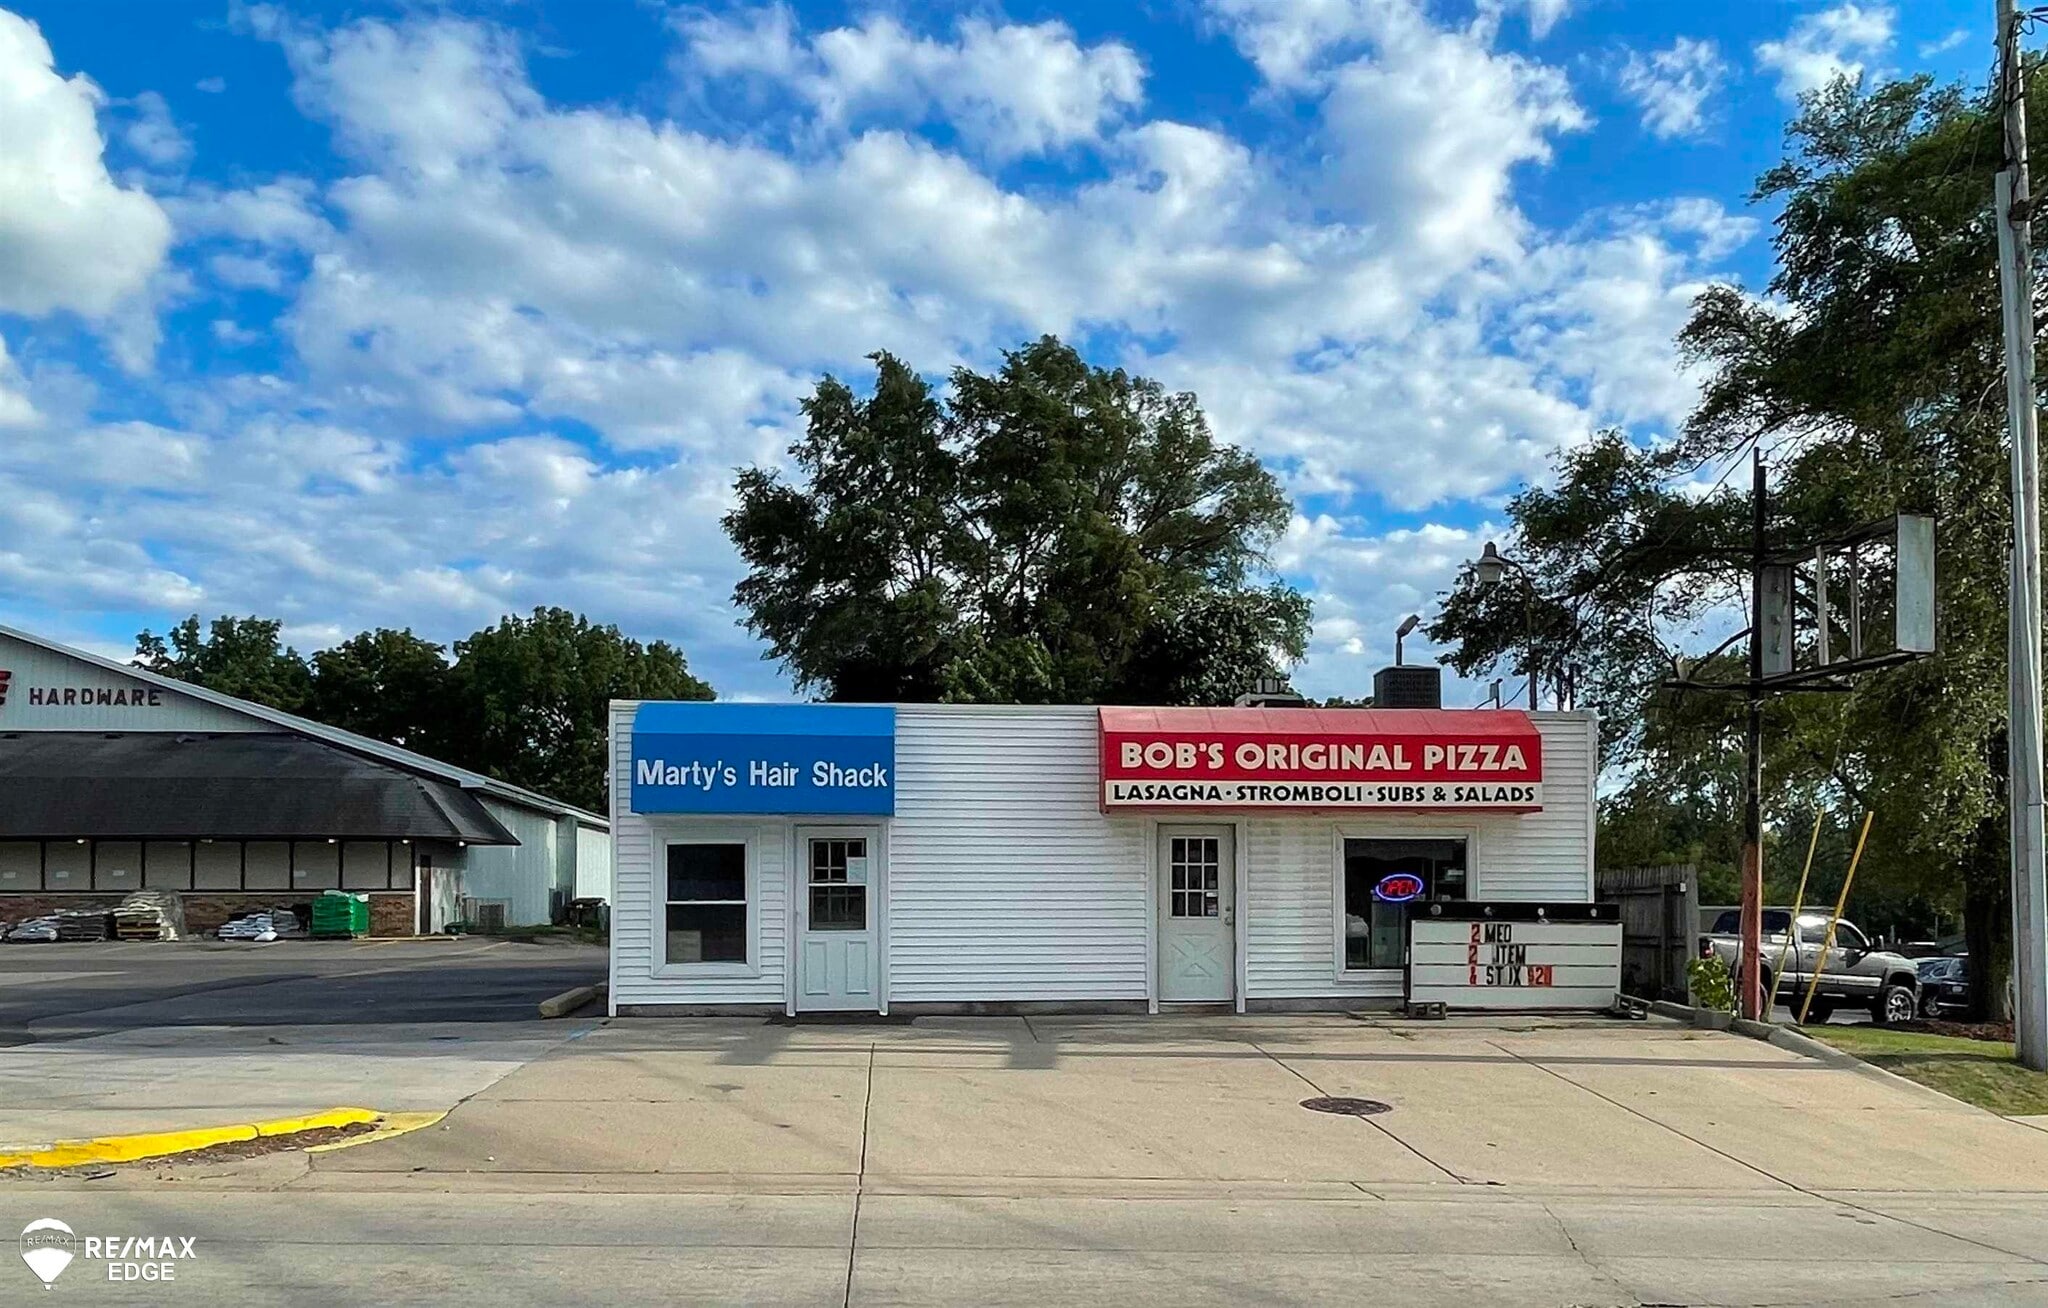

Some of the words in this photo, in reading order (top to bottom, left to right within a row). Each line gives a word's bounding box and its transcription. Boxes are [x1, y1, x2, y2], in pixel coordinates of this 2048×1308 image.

[29, 687, 162, 706] HARDWARE
[1121, 742, 1225, 770] BOB'S
[1235, 743, 1412, 770] ORIGINAL
[1424, 744, 1528, 771] PIZZA
[636, 759, 737, 791] Marty's
[750, 760, 799, 787] Hair
[812, 760, 888, 787] Shack
[1114, 784, 1223, 801] LASAGNA
[1237, 785, 1362, 801] STROMBOLI
[1377, 786, 1425, 802] SUBS
[1432, 786, 1447, 802] &
[1454, 786, 1535, 802] SALADS
[1380, 880, 1419, 896] OPEN
[1471, 923, 1480, 943] 2
[1468, 945, 1478, 964] 2
